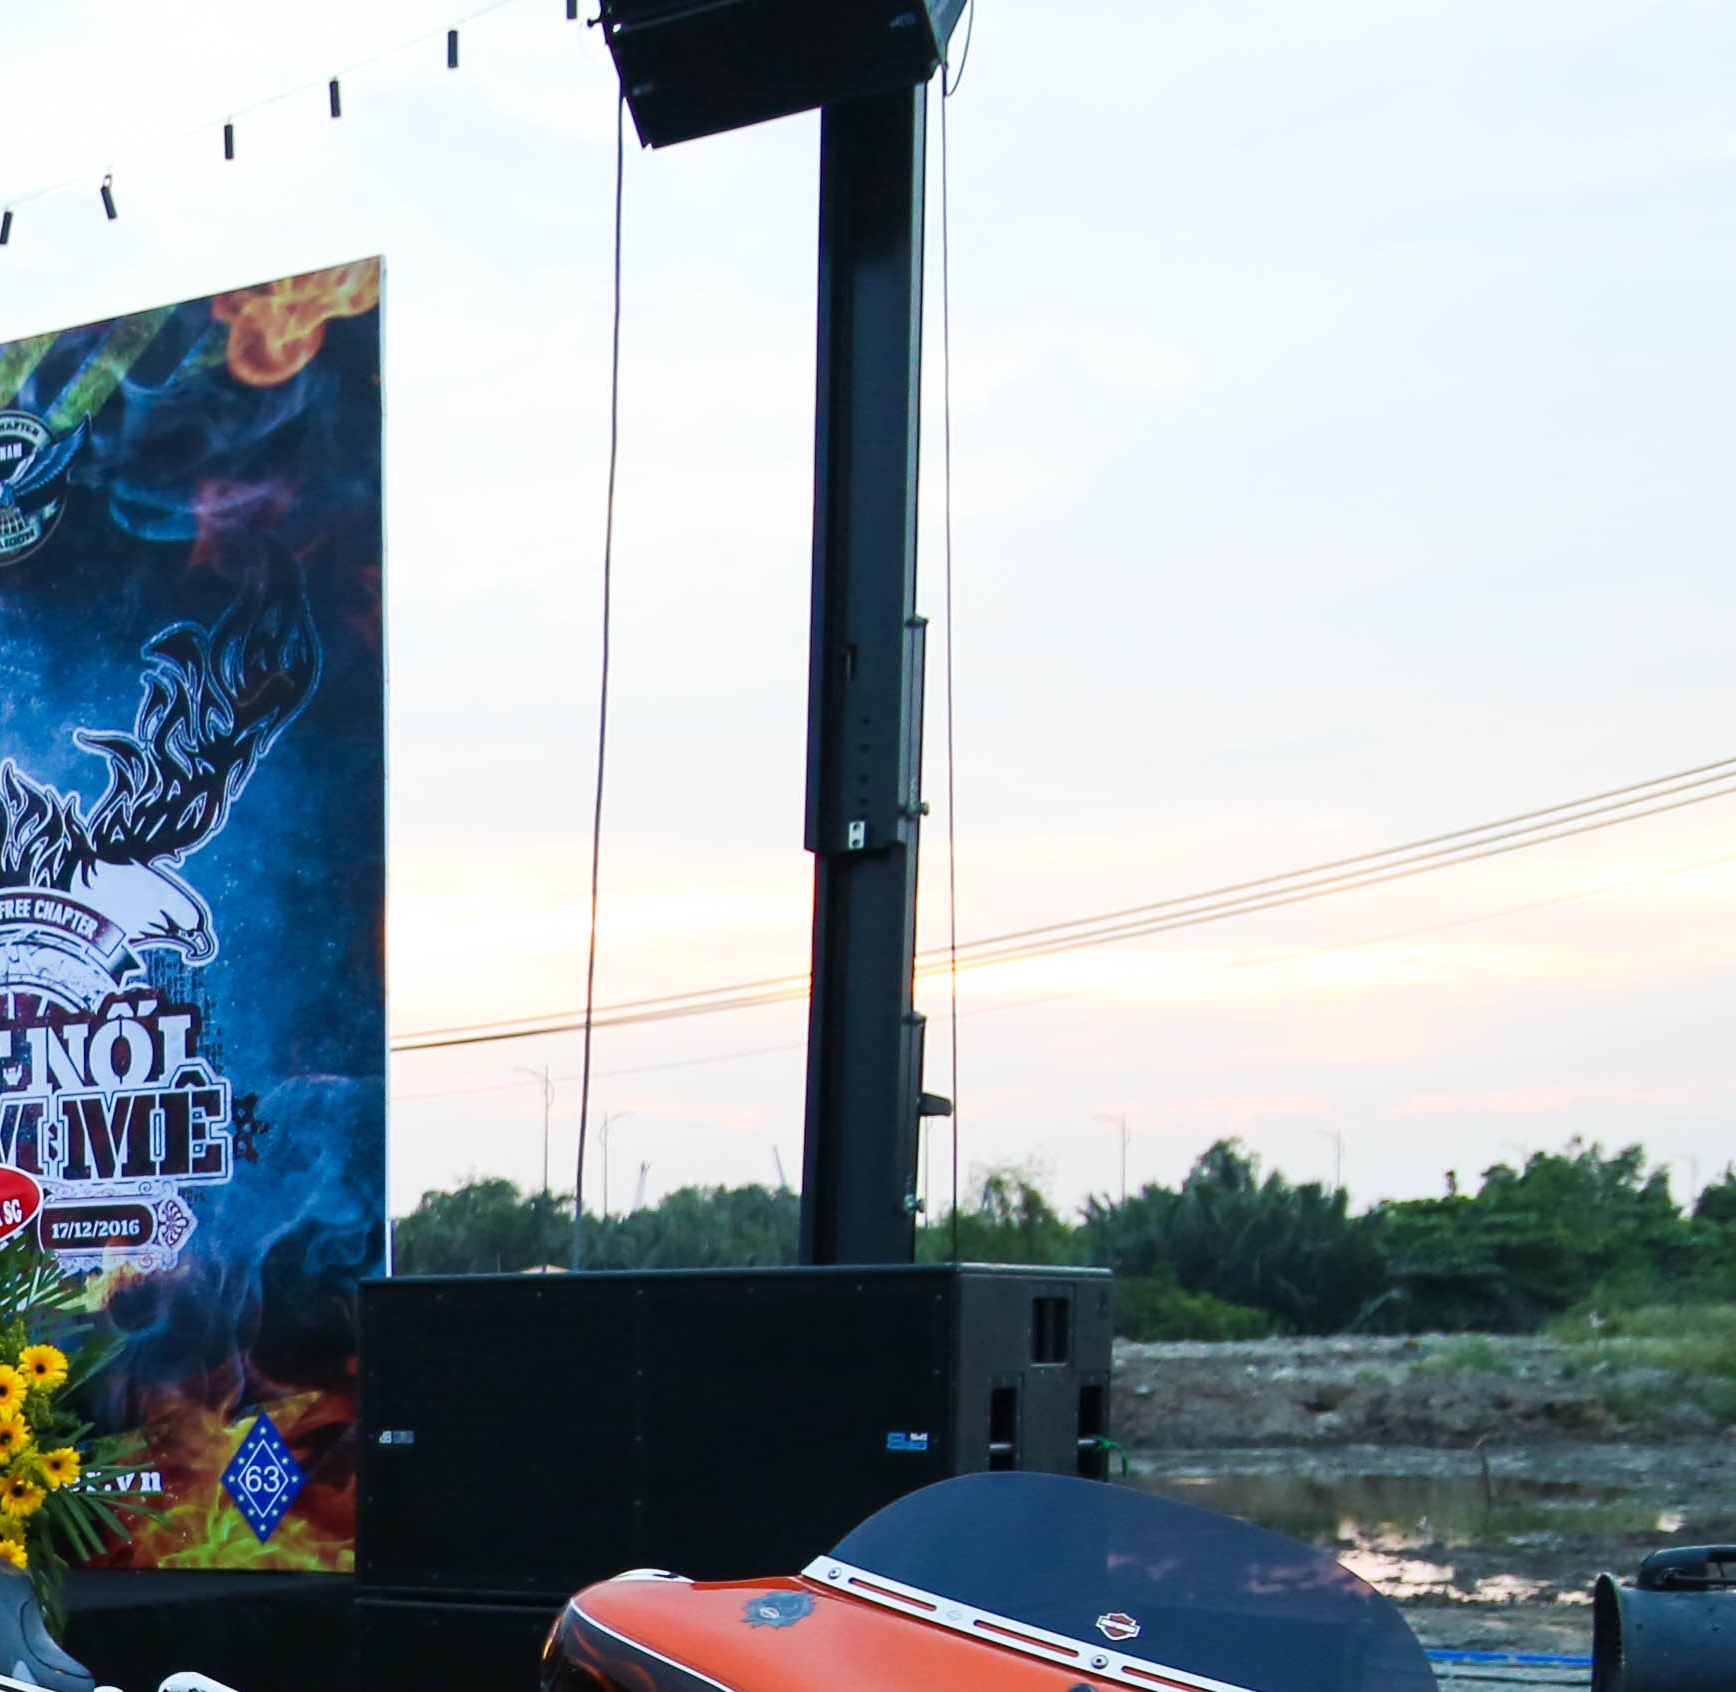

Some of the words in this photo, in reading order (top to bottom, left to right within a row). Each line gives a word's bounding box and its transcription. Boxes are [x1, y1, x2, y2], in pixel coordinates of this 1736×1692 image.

[33, 899, 100, 940] CHAPTER
[3, 1199, 23, 1225] SG
[50, 1218, 141, 1240] 17/12/2016
[245, 1464, 281, 1493] 63
